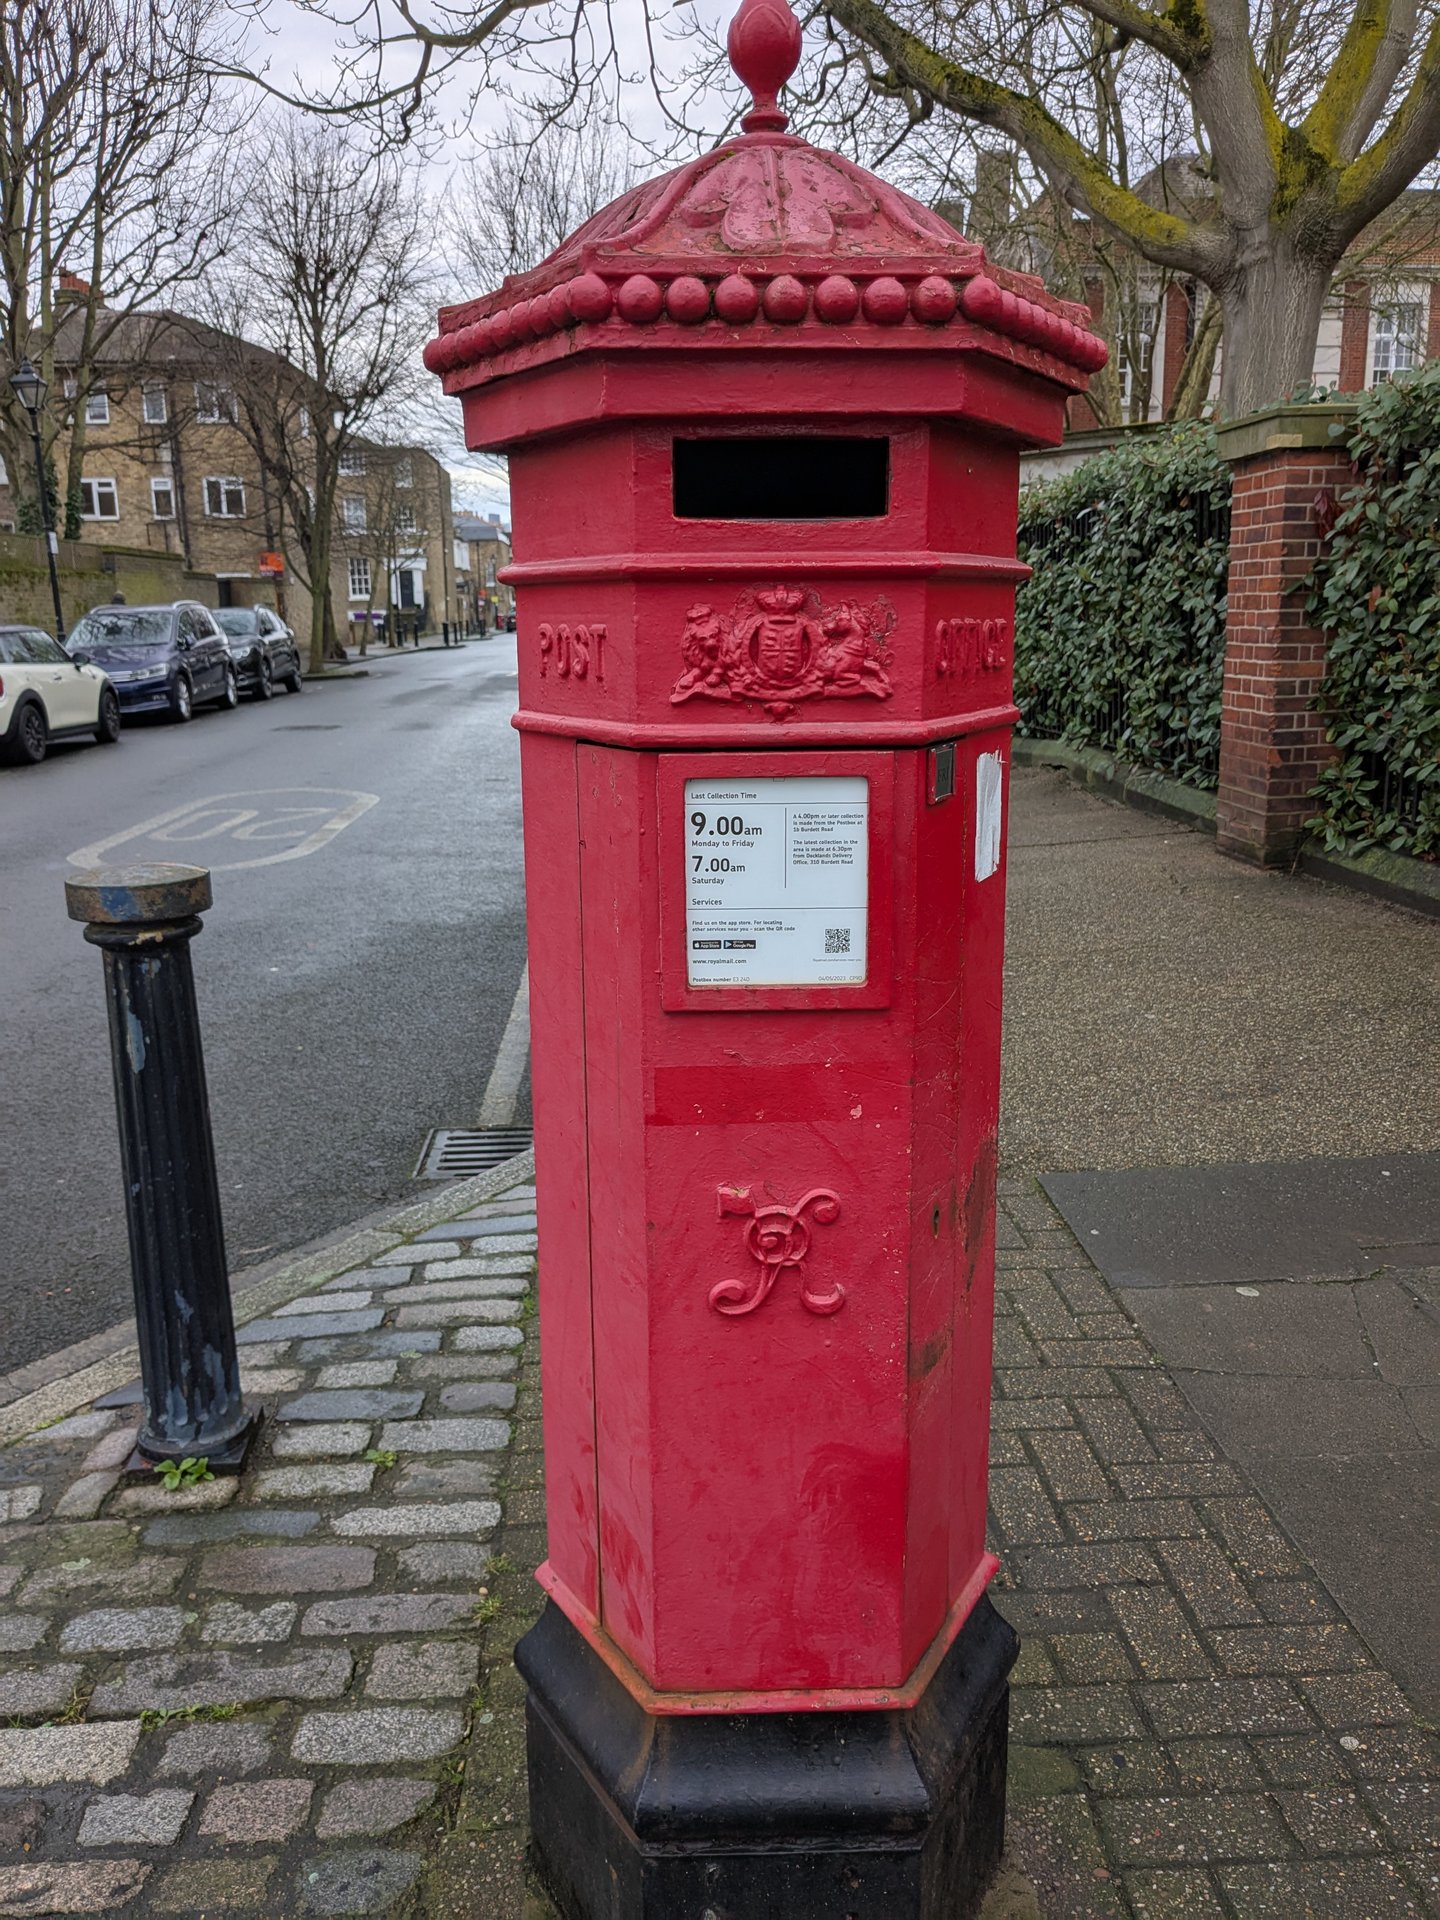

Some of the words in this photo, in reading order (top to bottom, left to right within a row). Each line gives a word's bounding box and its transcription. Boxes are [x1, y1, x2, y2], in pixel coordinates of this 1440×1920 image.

[538, 623, 607, 682] POST
[690, 812, 762, 836] 9.00am
[692, 856, 746, 872] 7.00am
